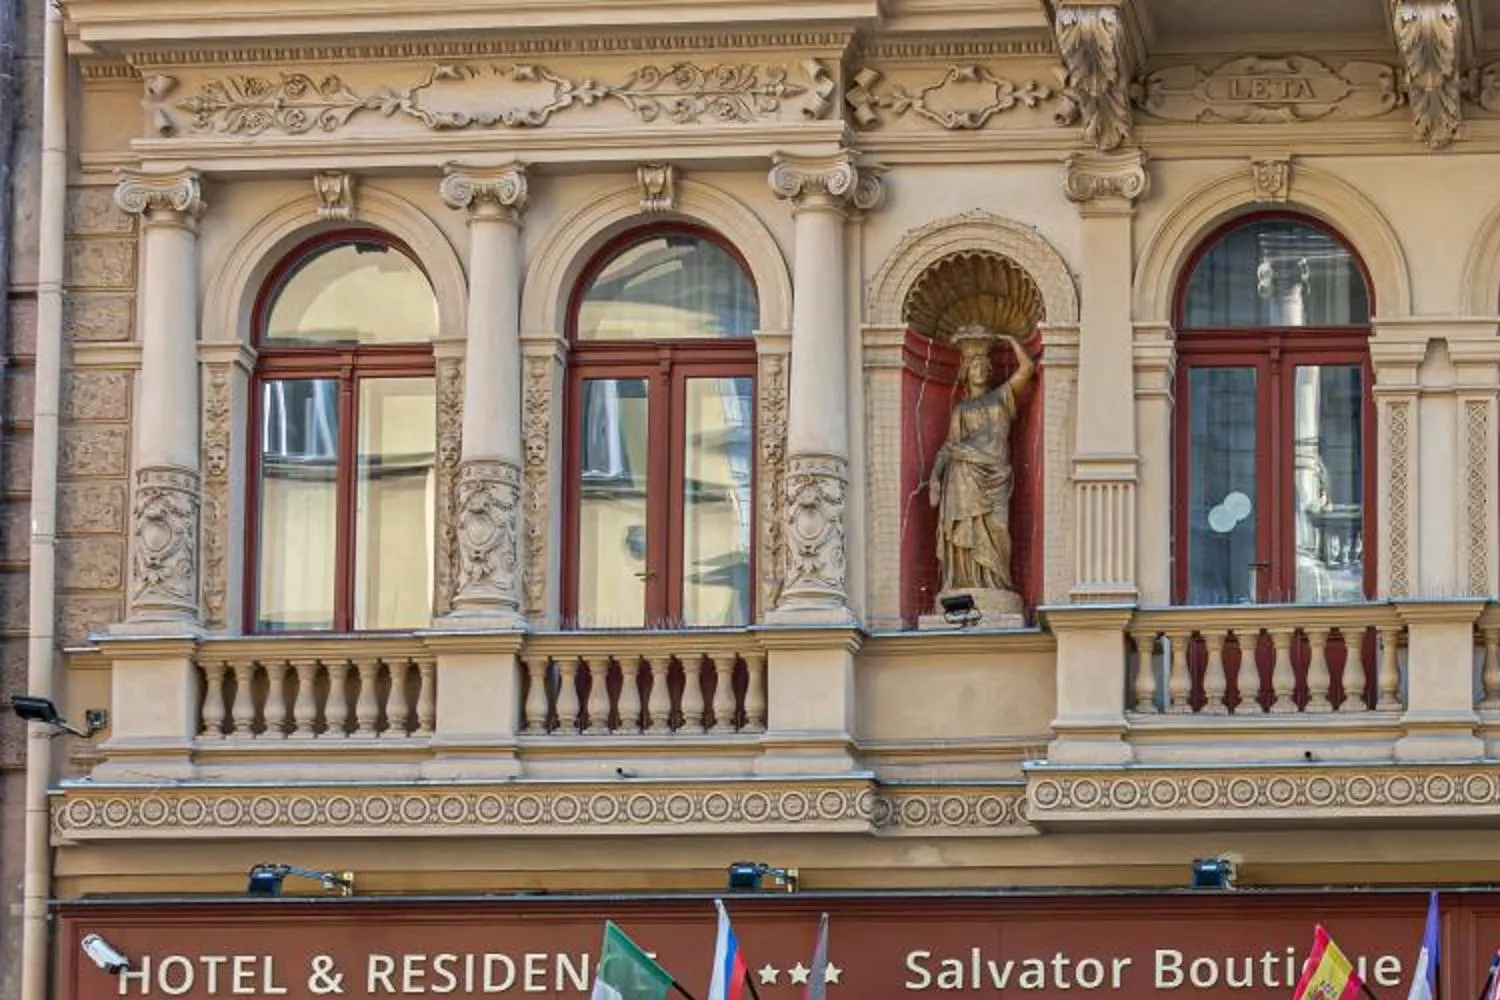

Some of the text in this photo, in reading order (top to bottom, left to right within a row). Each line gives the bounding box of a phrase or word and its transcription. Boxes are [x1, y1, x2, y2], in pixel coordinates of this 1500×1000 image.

[1229, 77, 1316, 100] LETA
[117, 954, 288, 996] HOTEL
[309, 955, 344, 996] &
[904, 946, 1403, 990] Salvator Boutie
